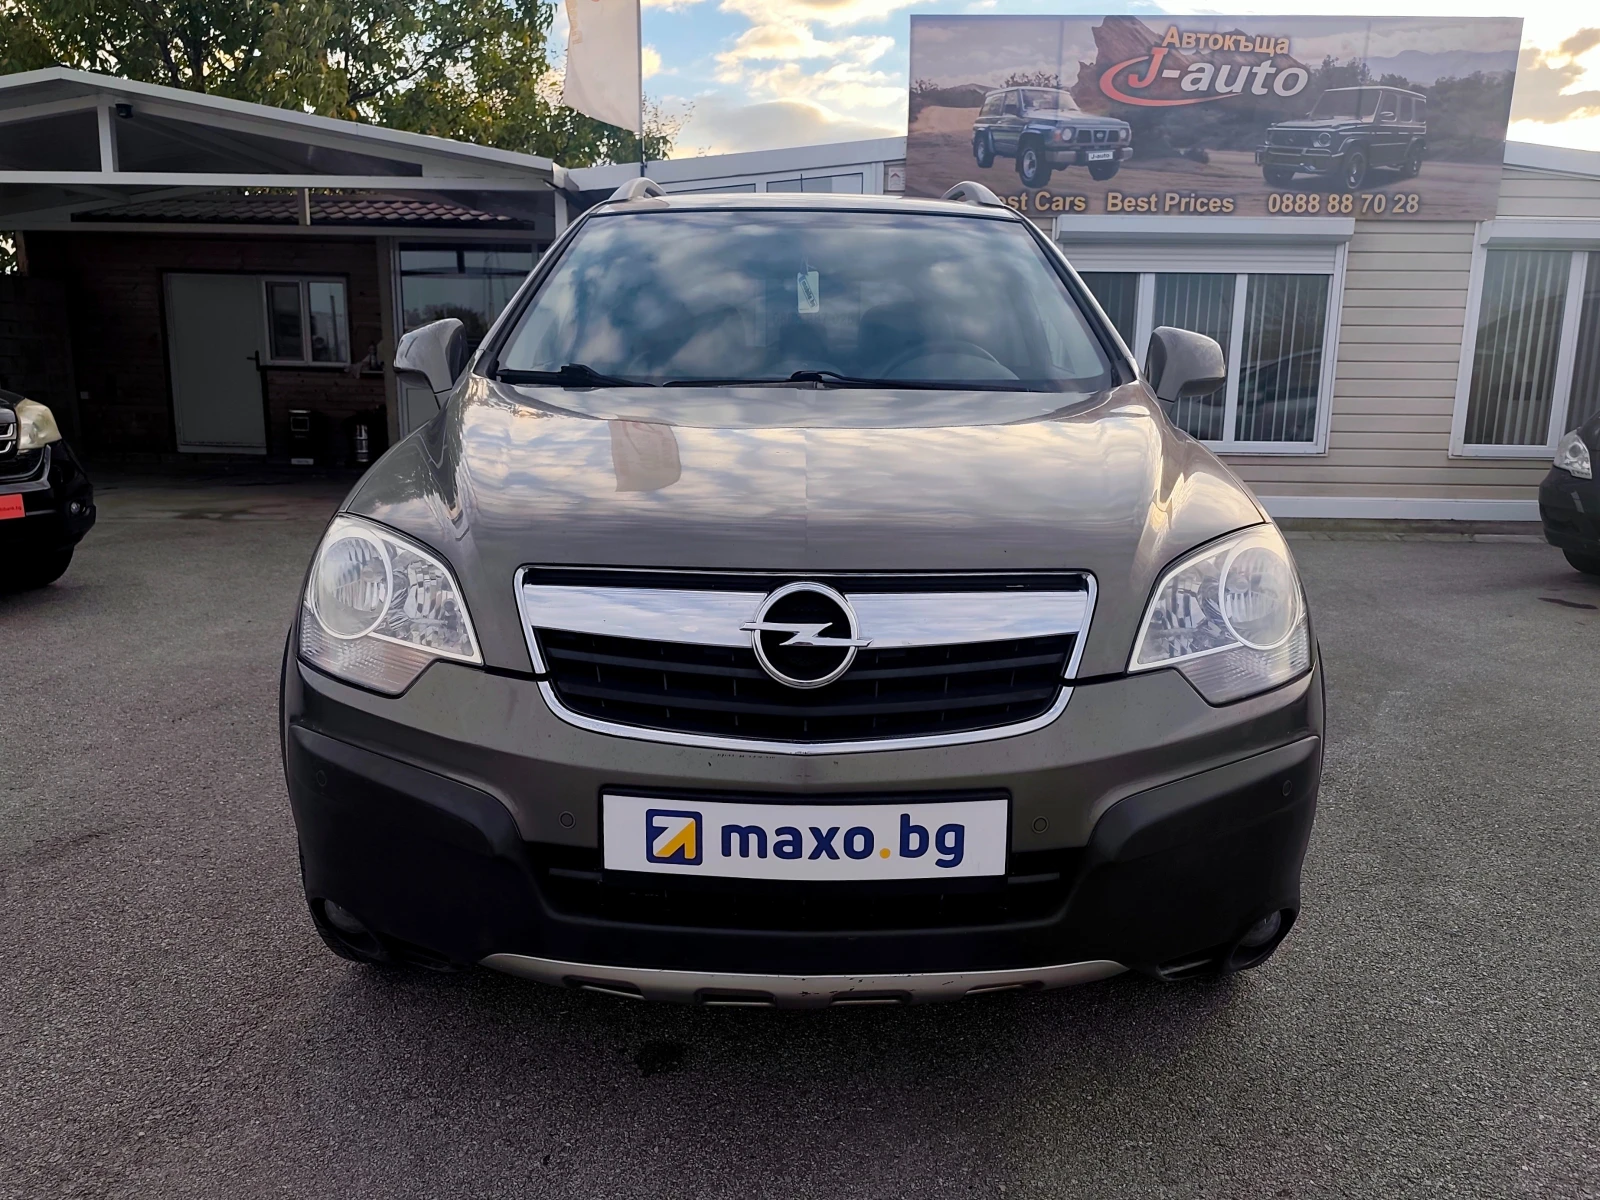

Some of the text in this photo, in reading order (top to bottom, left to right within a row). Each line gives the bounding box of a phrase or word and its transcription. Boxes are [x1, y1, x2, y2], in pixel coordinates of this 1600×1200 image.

[1162, 26, 1289, 55] Автокъща
[1128, 47, 1308, 97] J-auto
[1034, 192, 1086, 210] Cars
[1107, 193, 1234, 212] Best Prices
[1268, 193, 1419, 213] 0888 88 70 28
[721, 813, 965, 868] maxo.bg
